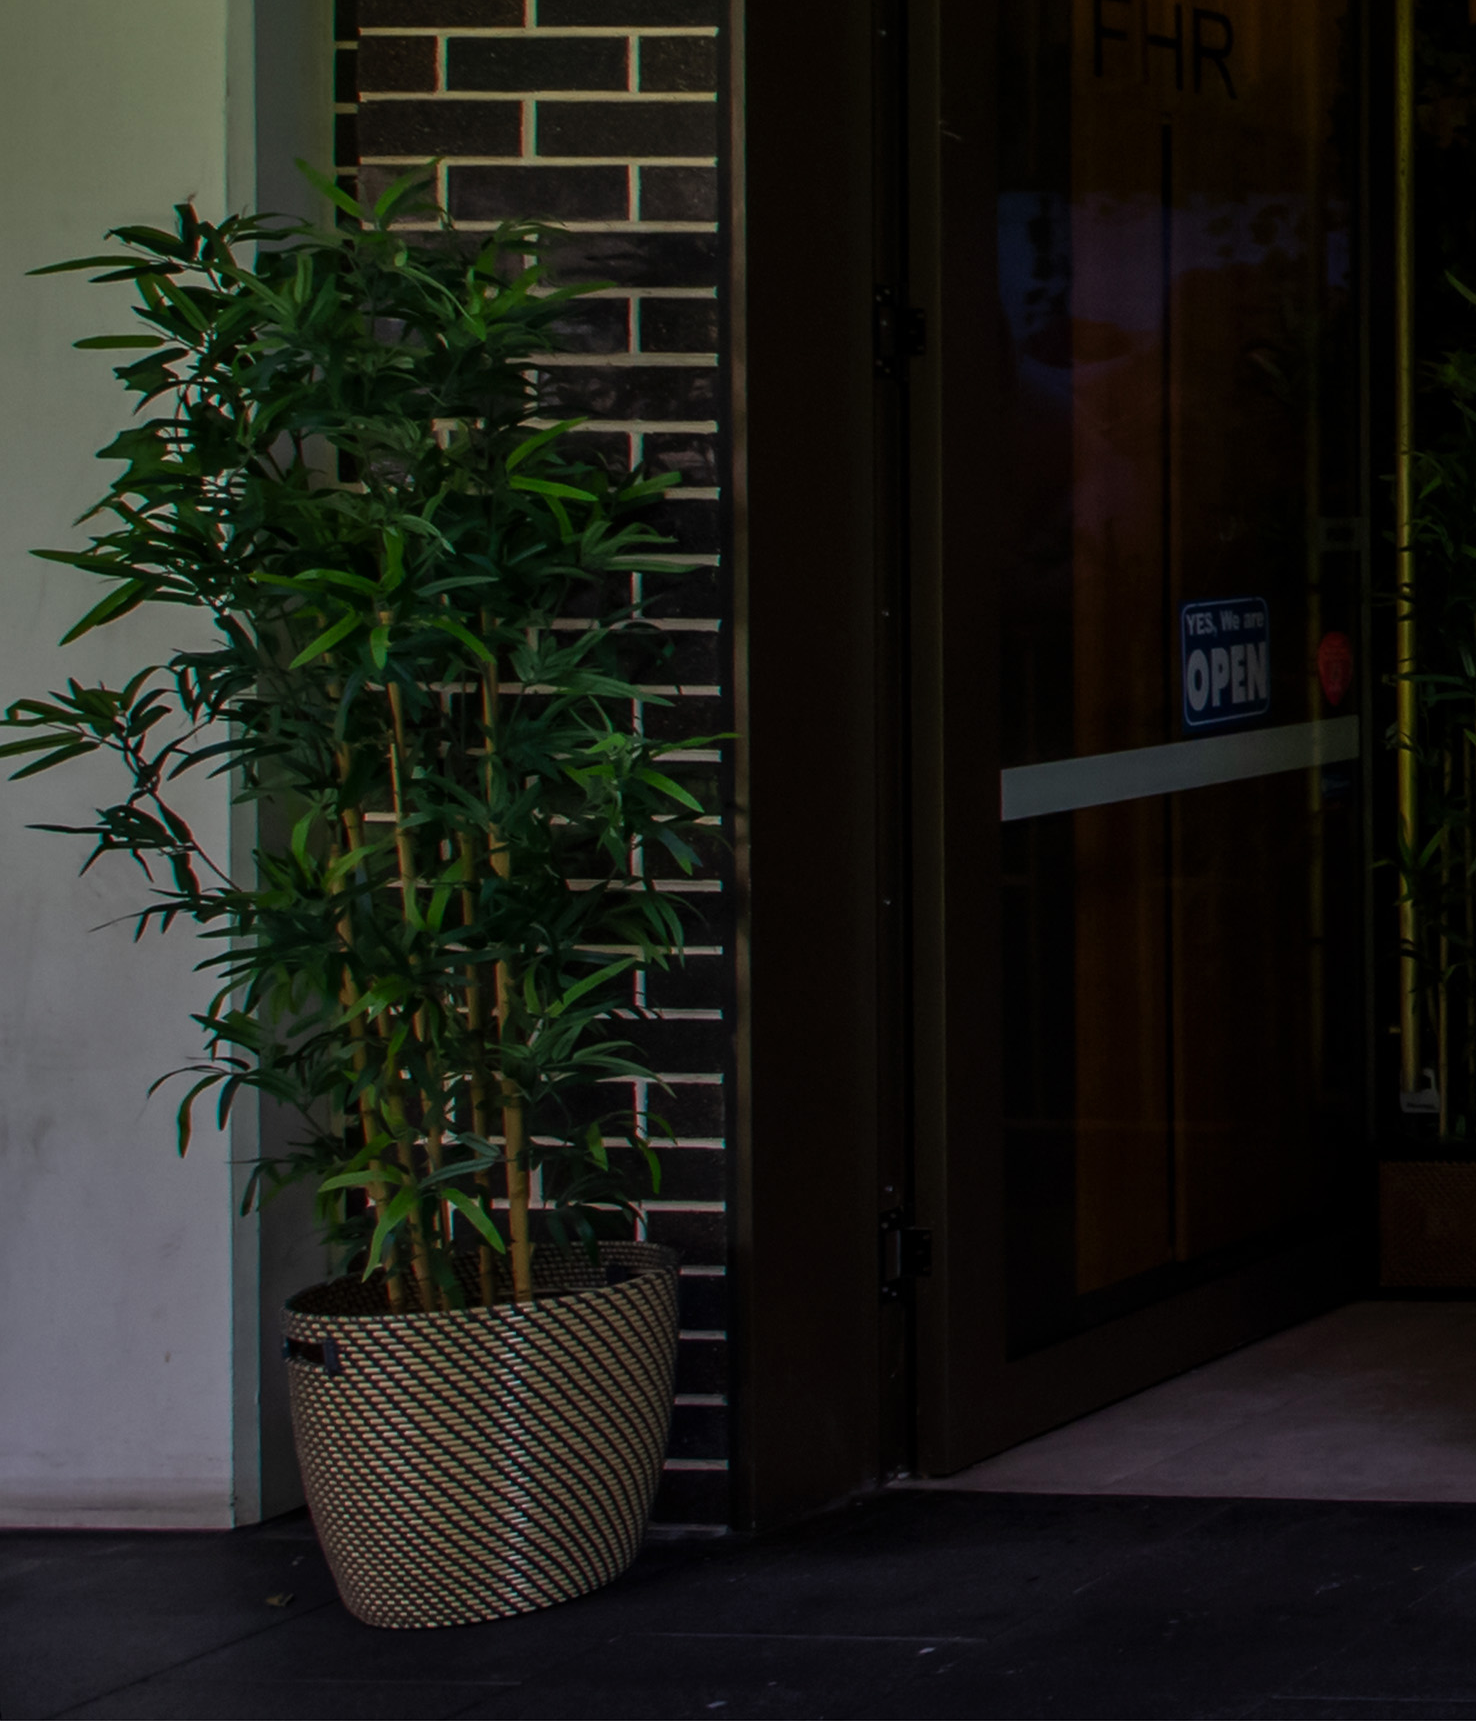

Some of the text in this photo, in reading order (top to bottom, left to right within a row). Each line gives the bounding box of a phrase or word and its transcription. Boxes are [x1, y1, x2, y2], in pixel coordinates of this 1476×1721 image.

[1185, 610, 1264, 638] YES, We are
[1186, 641, 1267, 712] OPEN
